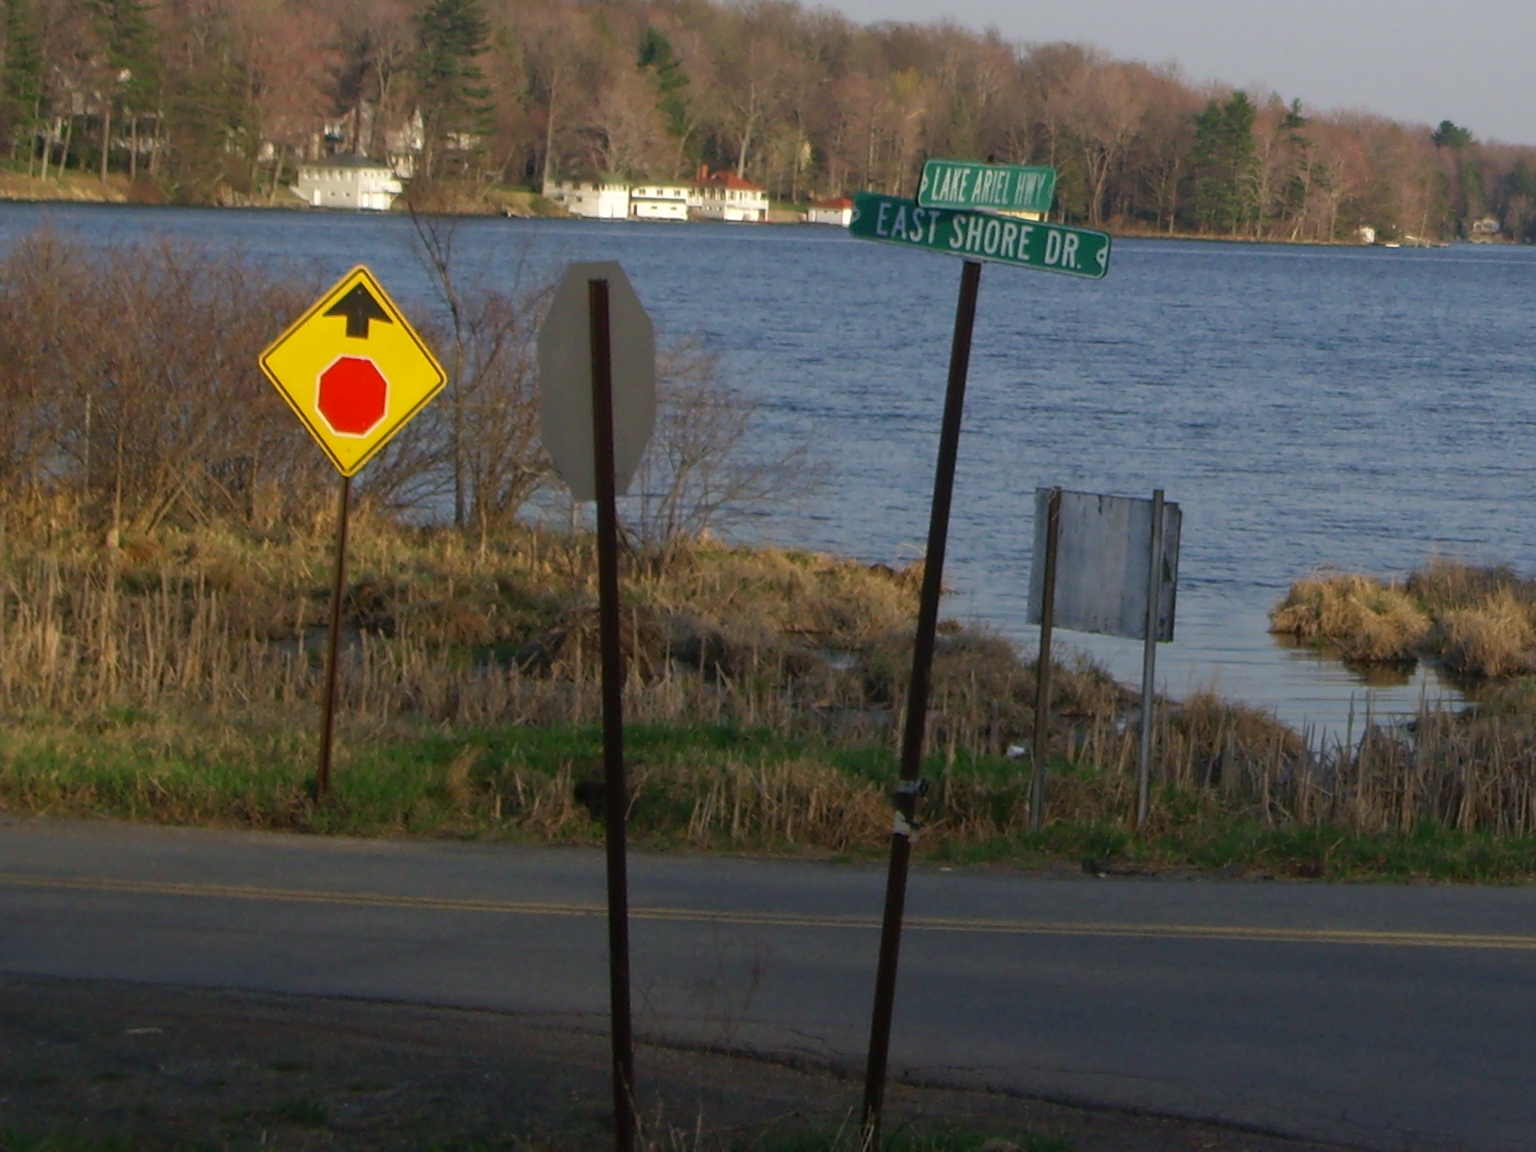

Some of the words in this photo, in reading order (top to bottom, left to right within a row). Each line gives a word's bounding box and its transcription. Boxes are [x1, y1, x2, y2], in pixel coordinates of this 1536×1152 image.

[931, 166, 970, 203] LAKE
[971, 169, 1010, 205] ARIEL
[1014, 172, 1046, 206] HWY
[875, 201, 939, 245] EAST
[949, 214, 1034, 261] SHORE
[1044, 230, 1082, 269] DR.
